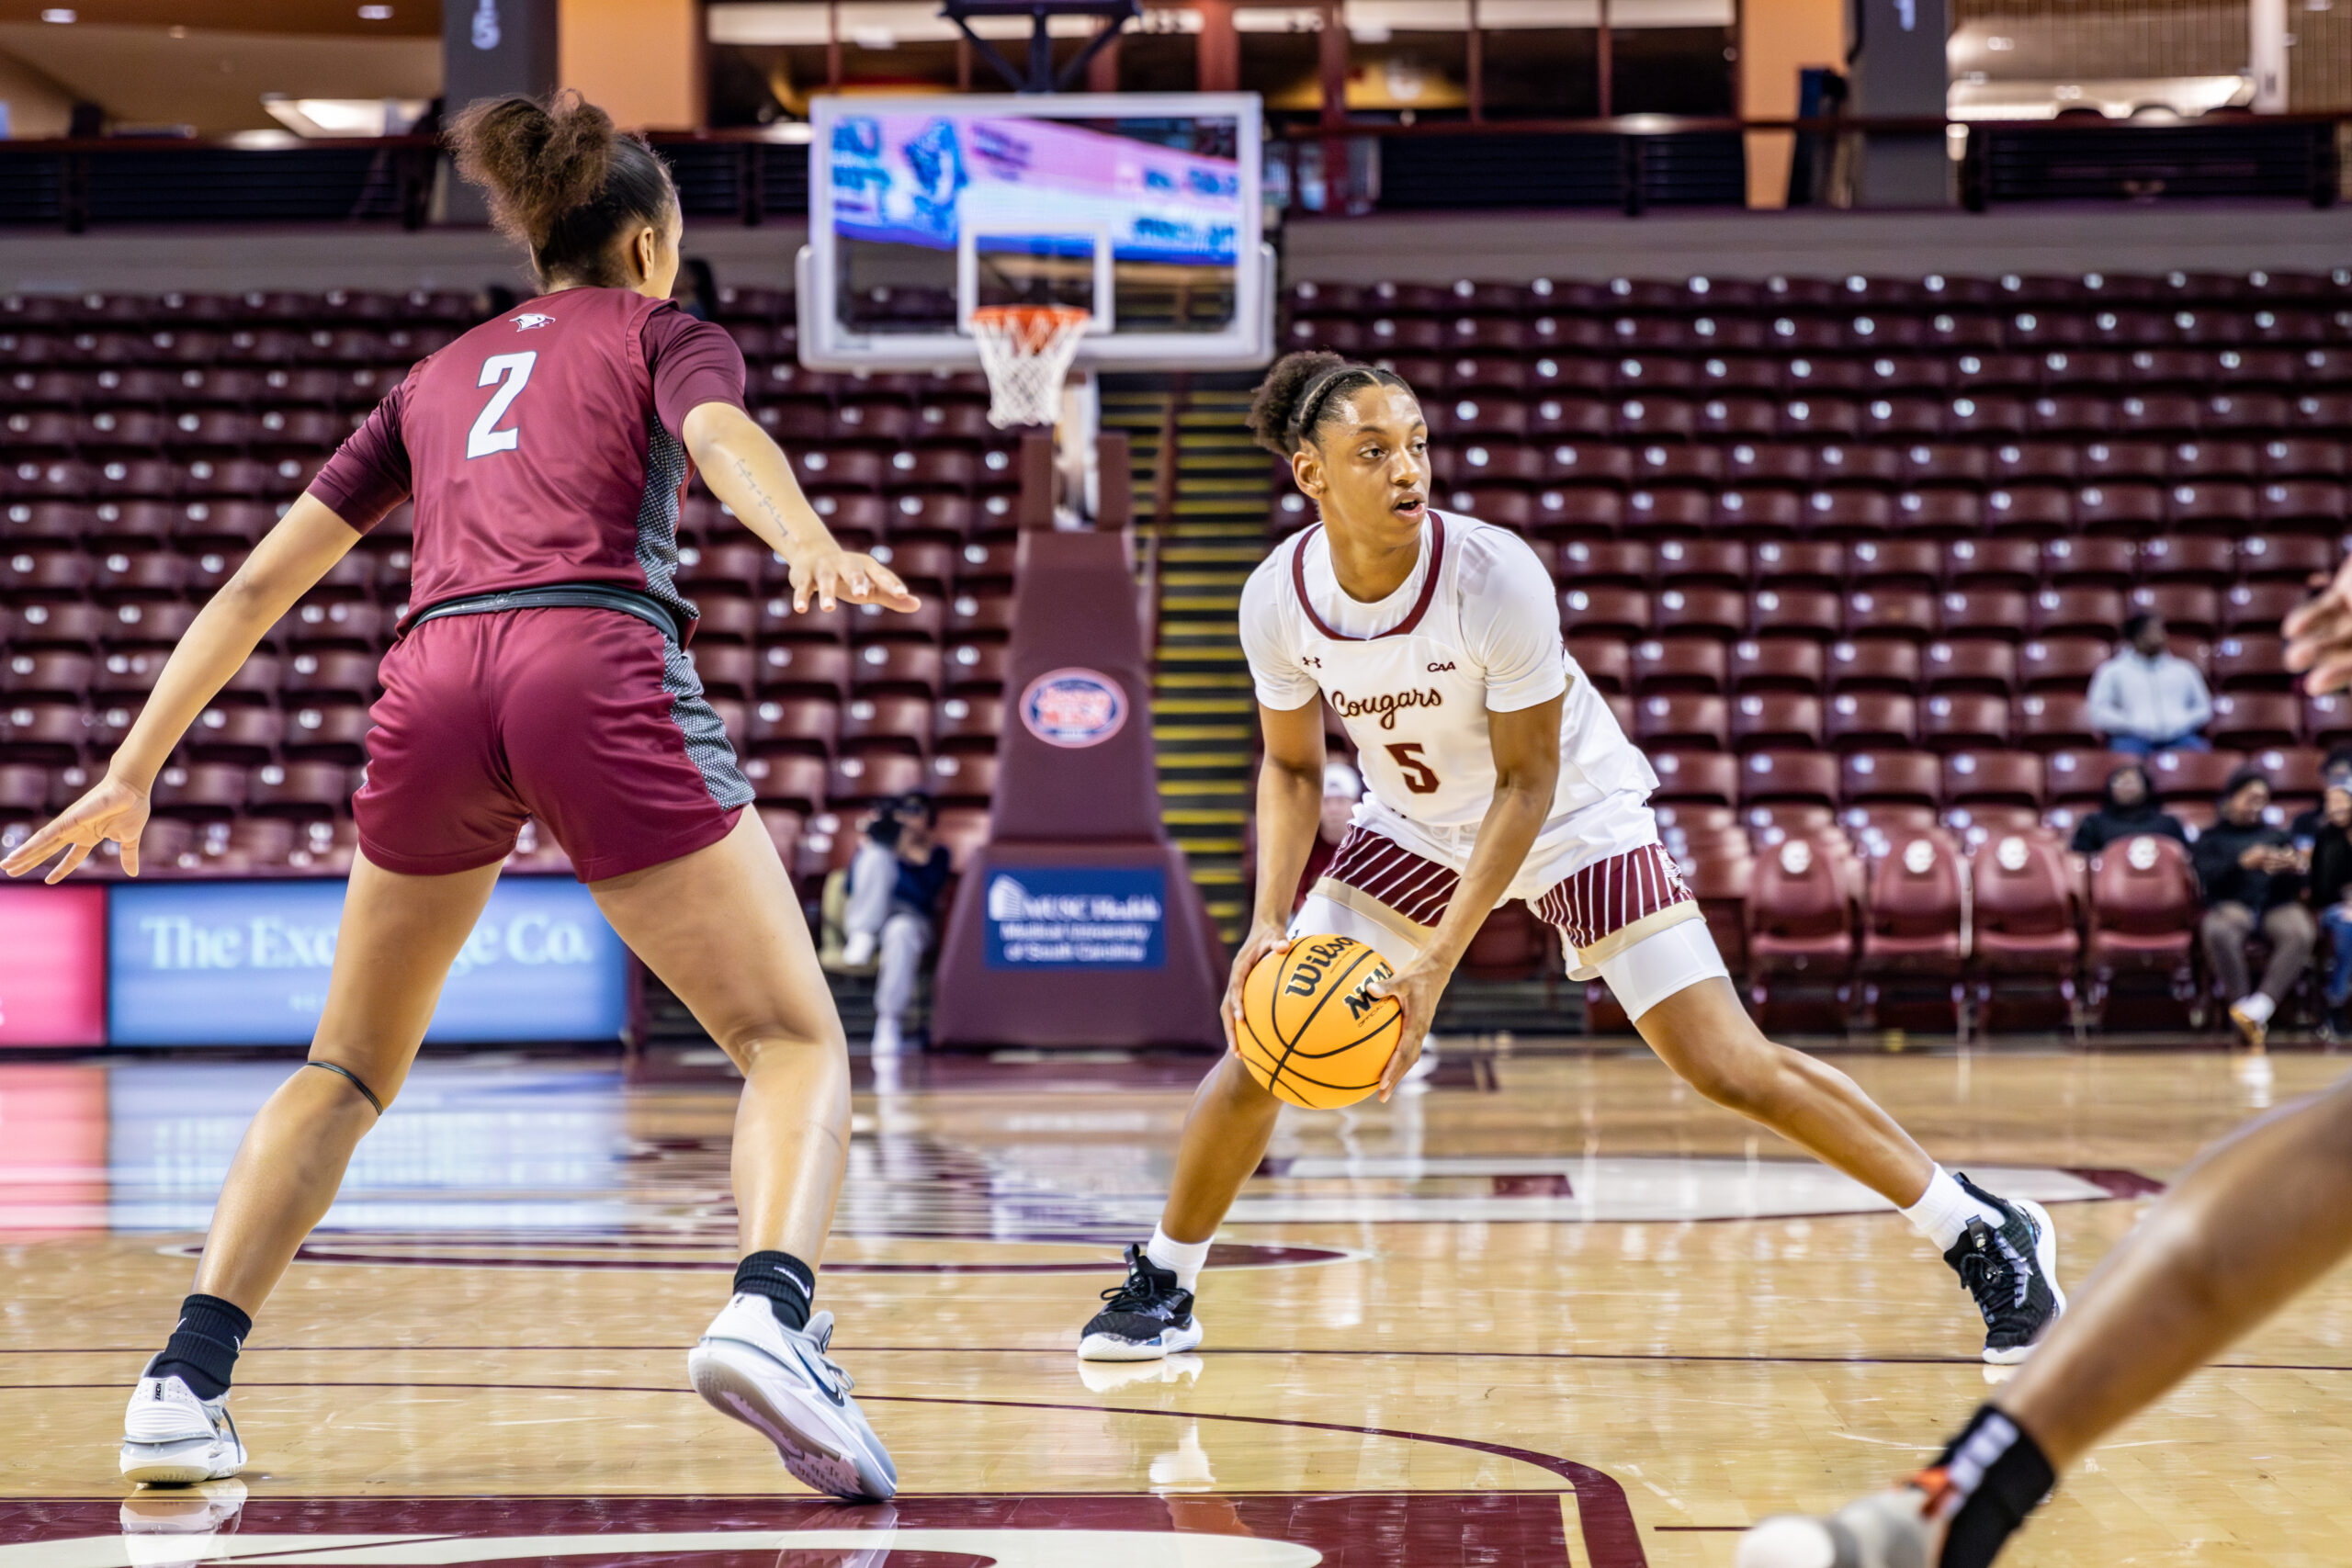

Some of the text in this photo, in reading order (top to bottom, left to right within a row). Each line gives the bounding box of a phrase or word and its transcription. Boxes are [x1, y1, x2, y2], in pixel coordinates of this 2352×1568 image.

[466, 350, 538, 460] 2
[1426, 660, 1456, 672] CAA
[1332, 688, 1442, 730] Cougars
[1382, 742, 1441, 795] 5
[140, 916, 242, 968] The
